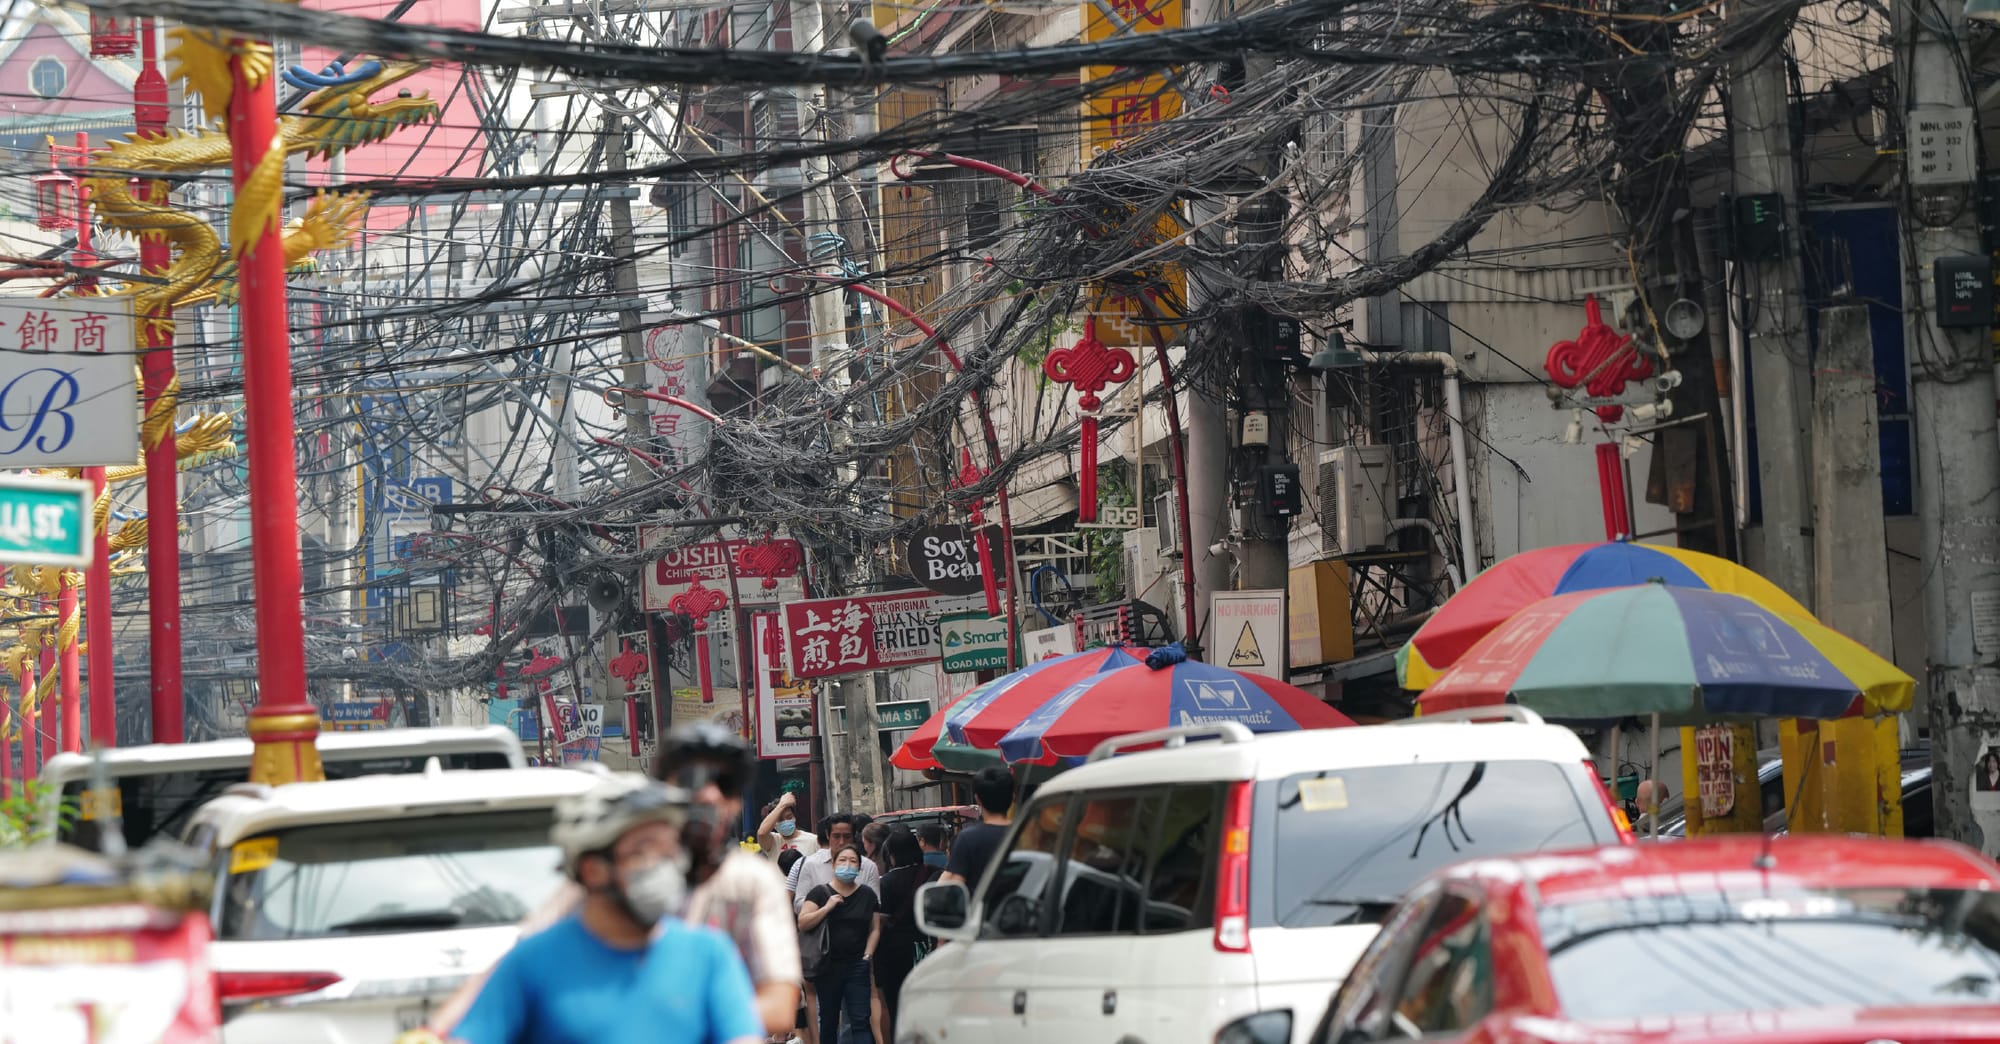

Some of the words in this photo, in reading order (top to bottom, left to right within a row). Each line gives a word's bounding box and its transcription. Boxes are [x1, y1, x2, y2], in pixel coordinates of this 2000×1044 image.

[0, 311, 108, 351] 飾商
[872, 603, 888, 613] THE
[889, 600, 930, 613] ORIGINAL
[1218, 604, 1231, 616] NO
[1234, 603, 1277, 616] PARKING
[796, 601, 869, 636] 上海
[873, 628, 930, 649] FRIED
[963, 629, 1008, 644] Smart
[801, 634, 868, 672] 煎包
[946, 660, 973, 670] LOAD
[975, 658, 989, 667] NA
[991, 657, 1008, 665] DIT
[904, 708, 922, 721] ST.
